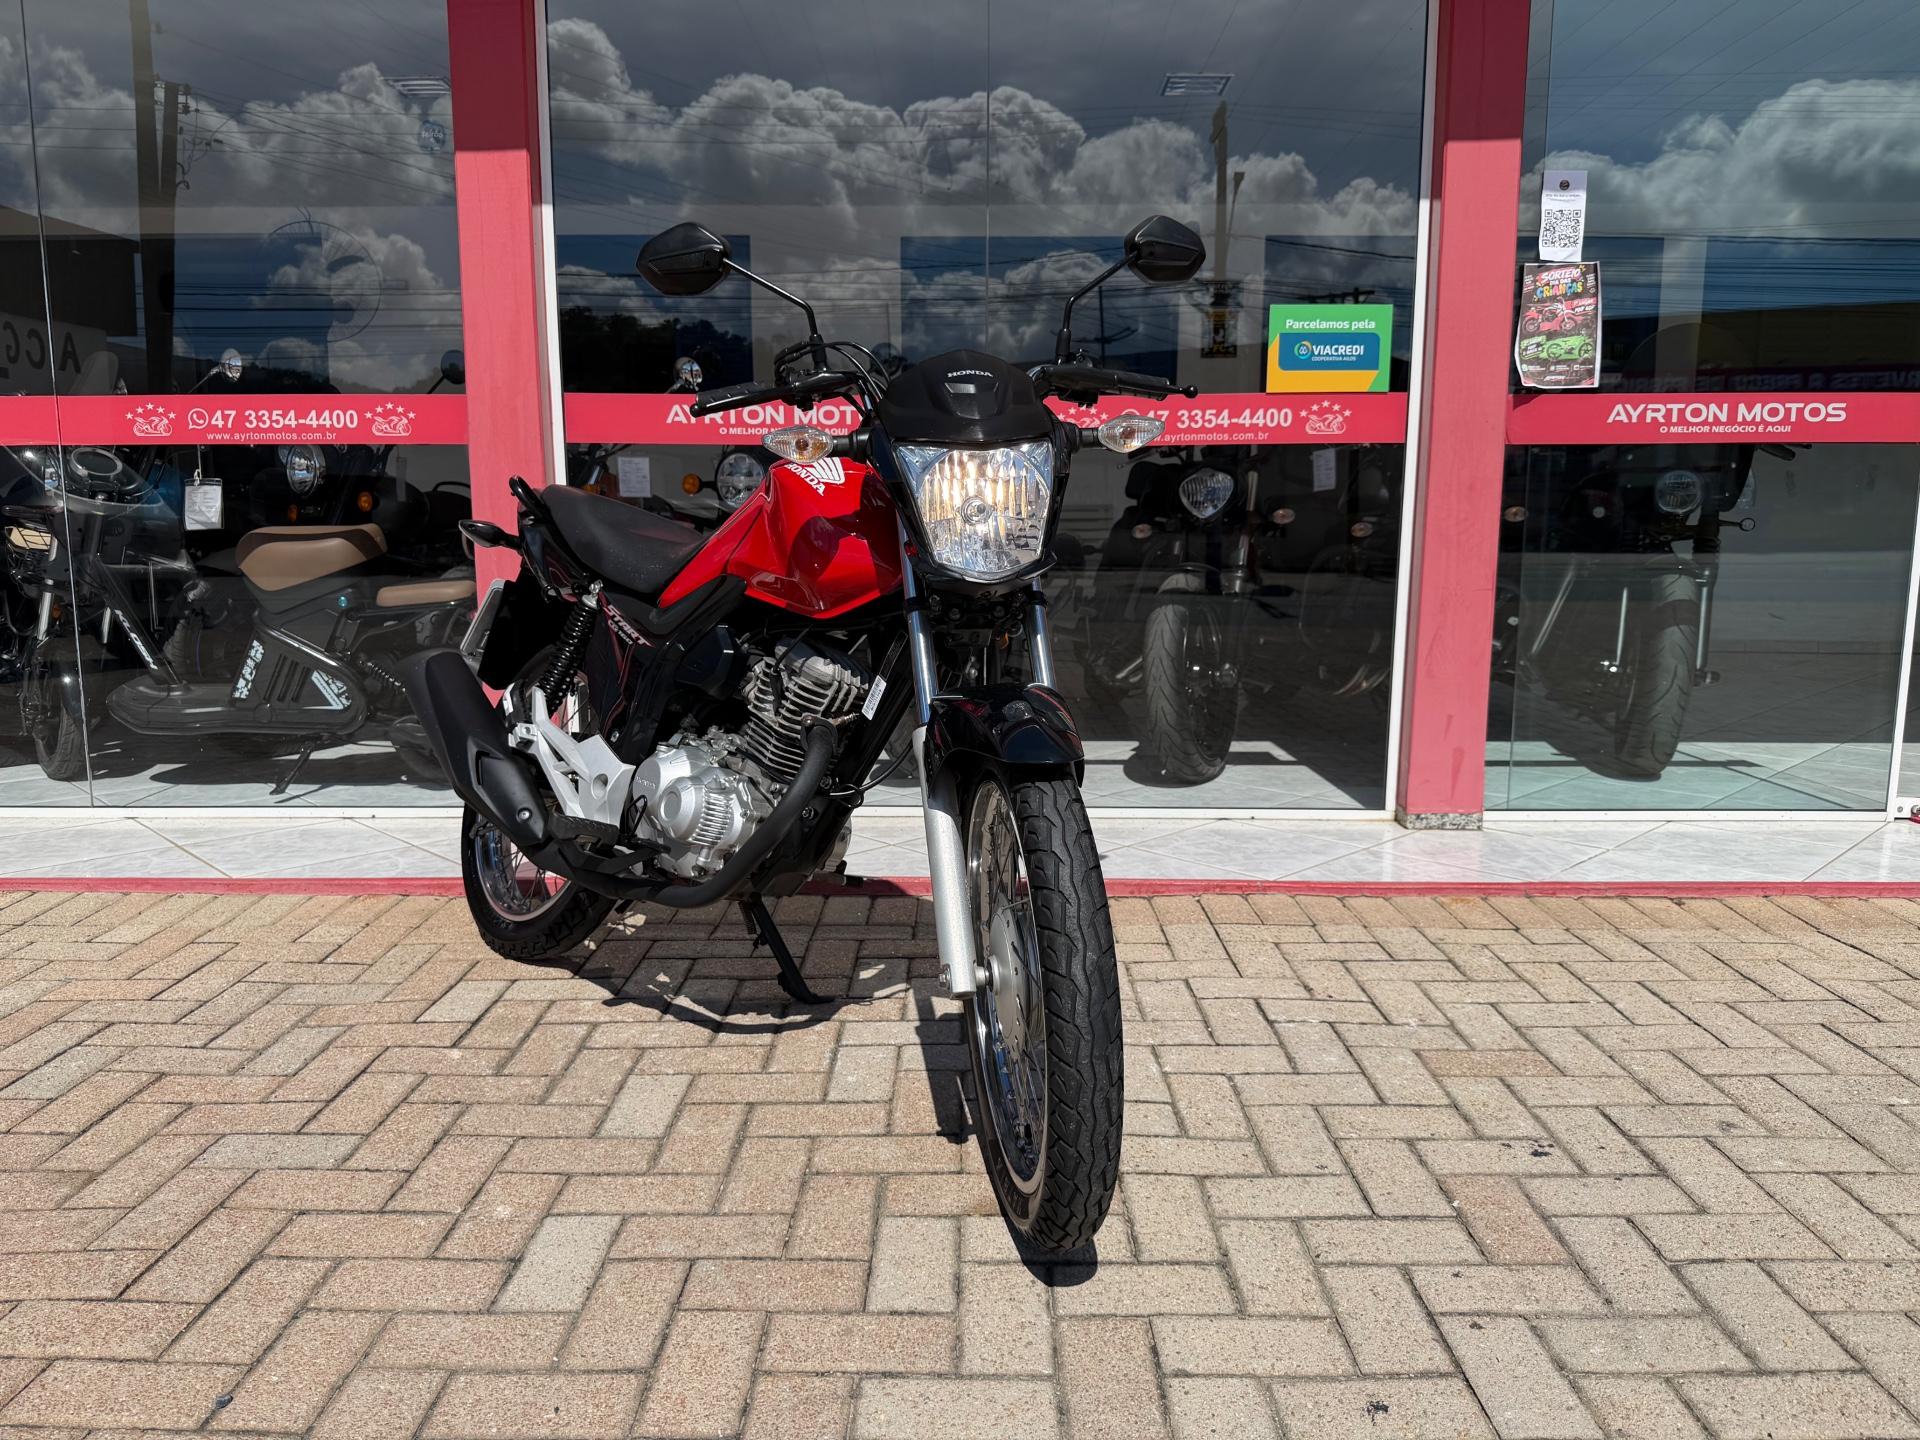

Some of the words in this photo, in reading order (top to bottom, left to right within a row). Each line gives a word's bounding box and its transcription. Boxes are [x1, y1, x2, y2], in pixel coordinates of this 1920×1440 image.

[1541, 268, 1581, 280] SORTEIO
[1536, 281, 1583, 298] CRIANÇAS
[1285, 319, 1349, 329] Parcelamos
[1351, 319, 1376, 331] pela
[1312, 344, 1364, 356] VIACREDI
[947, 369, 993, 378] HONDA
[211, 409, 237, 429] 47
[244, 409, 359, 429] 3354-4400
[794, 404, 863, 426] MOT
[1177, 408, 1292, 429] 3354-4400
[1606, 402, 1729, 424] AYRTON
[1737, 402, 1848, 423] MOTOS
[719, 427, 728, 435] O
[729, 427, 768, 436] MELHOR
[1659, 426, 1668, 434] O
[1669, 425, 1710, 434] MELHOR
[1712, 423, 1756, 433] NEGÓCIO
[1758, 423, 1765, 433] É
[1766, 425, 1792, 434] AQUI
[207, 431, 337, 442] www.ayrtonmotos.com.br
[783, 463, 826, 497] HONDA
[603, 604, 652, 647] START
